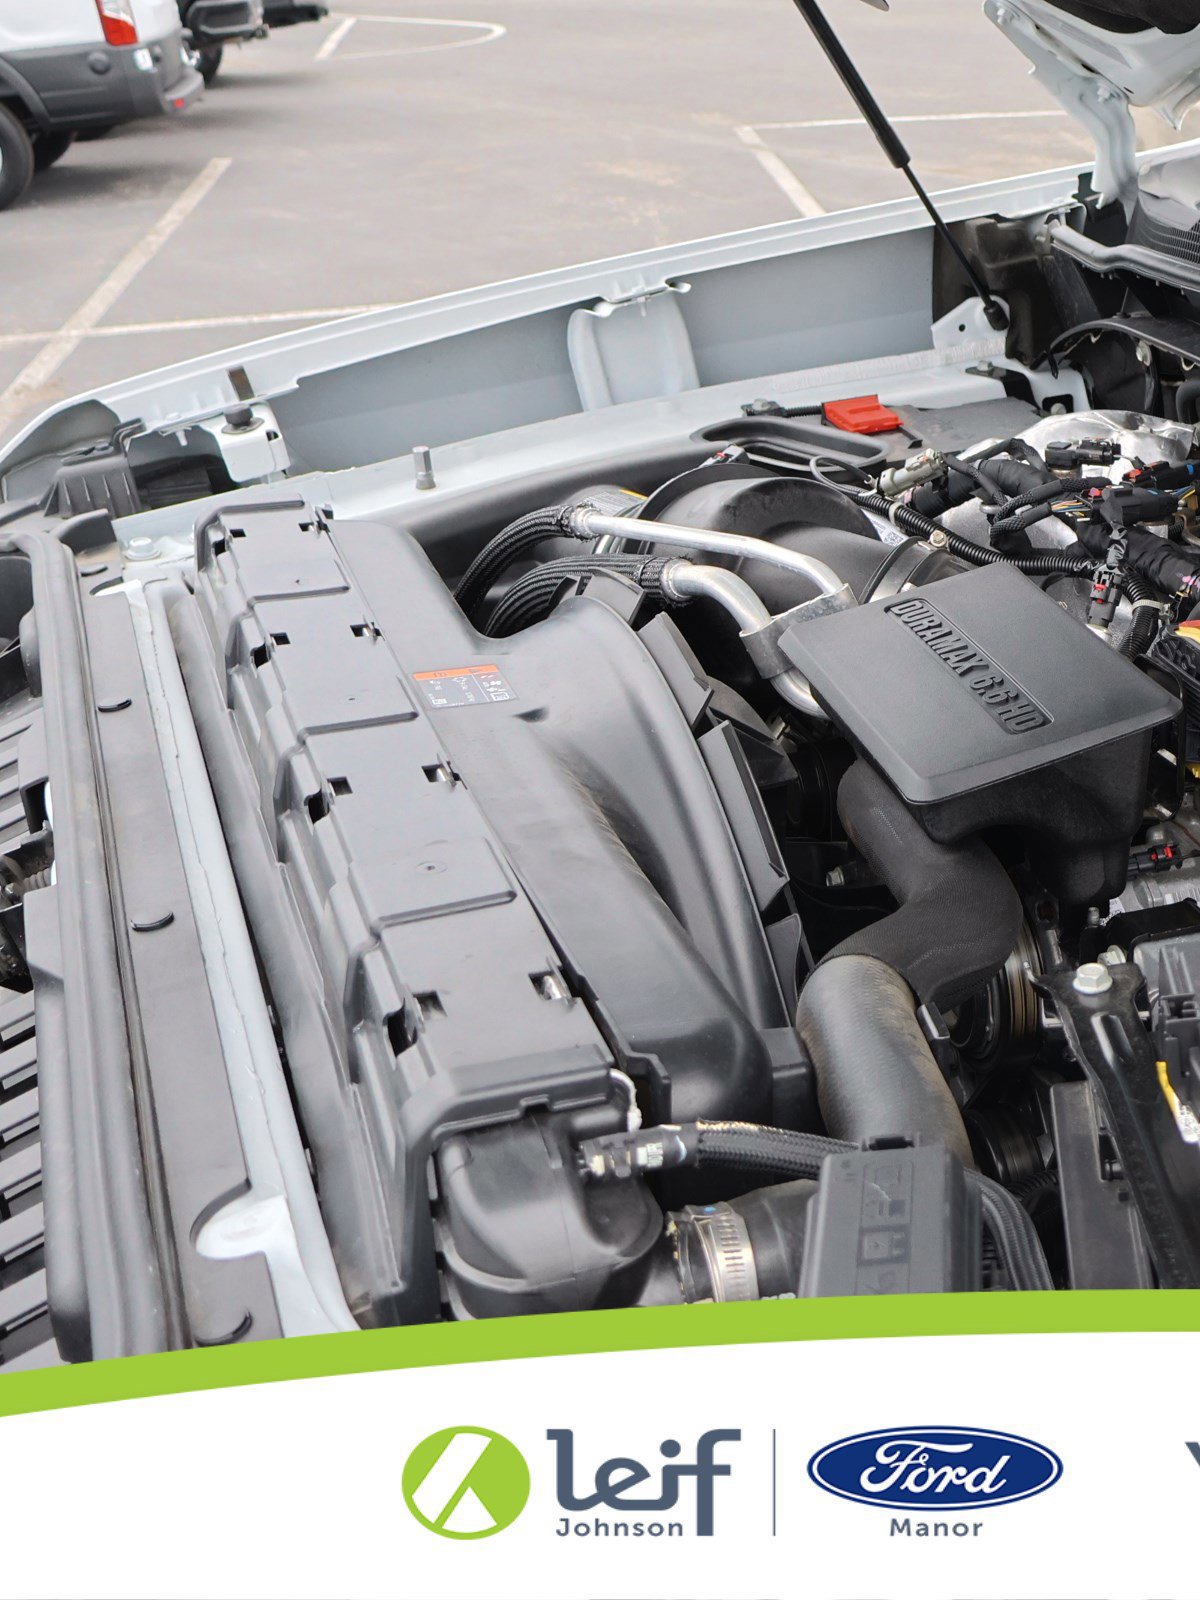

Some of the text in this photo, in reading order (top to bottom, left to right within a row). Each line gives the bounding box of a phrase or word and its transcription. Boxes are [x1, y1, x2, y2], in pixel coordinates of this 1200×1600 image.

[889, 600, 1047, 733] DURAMAX 6.6 HD
